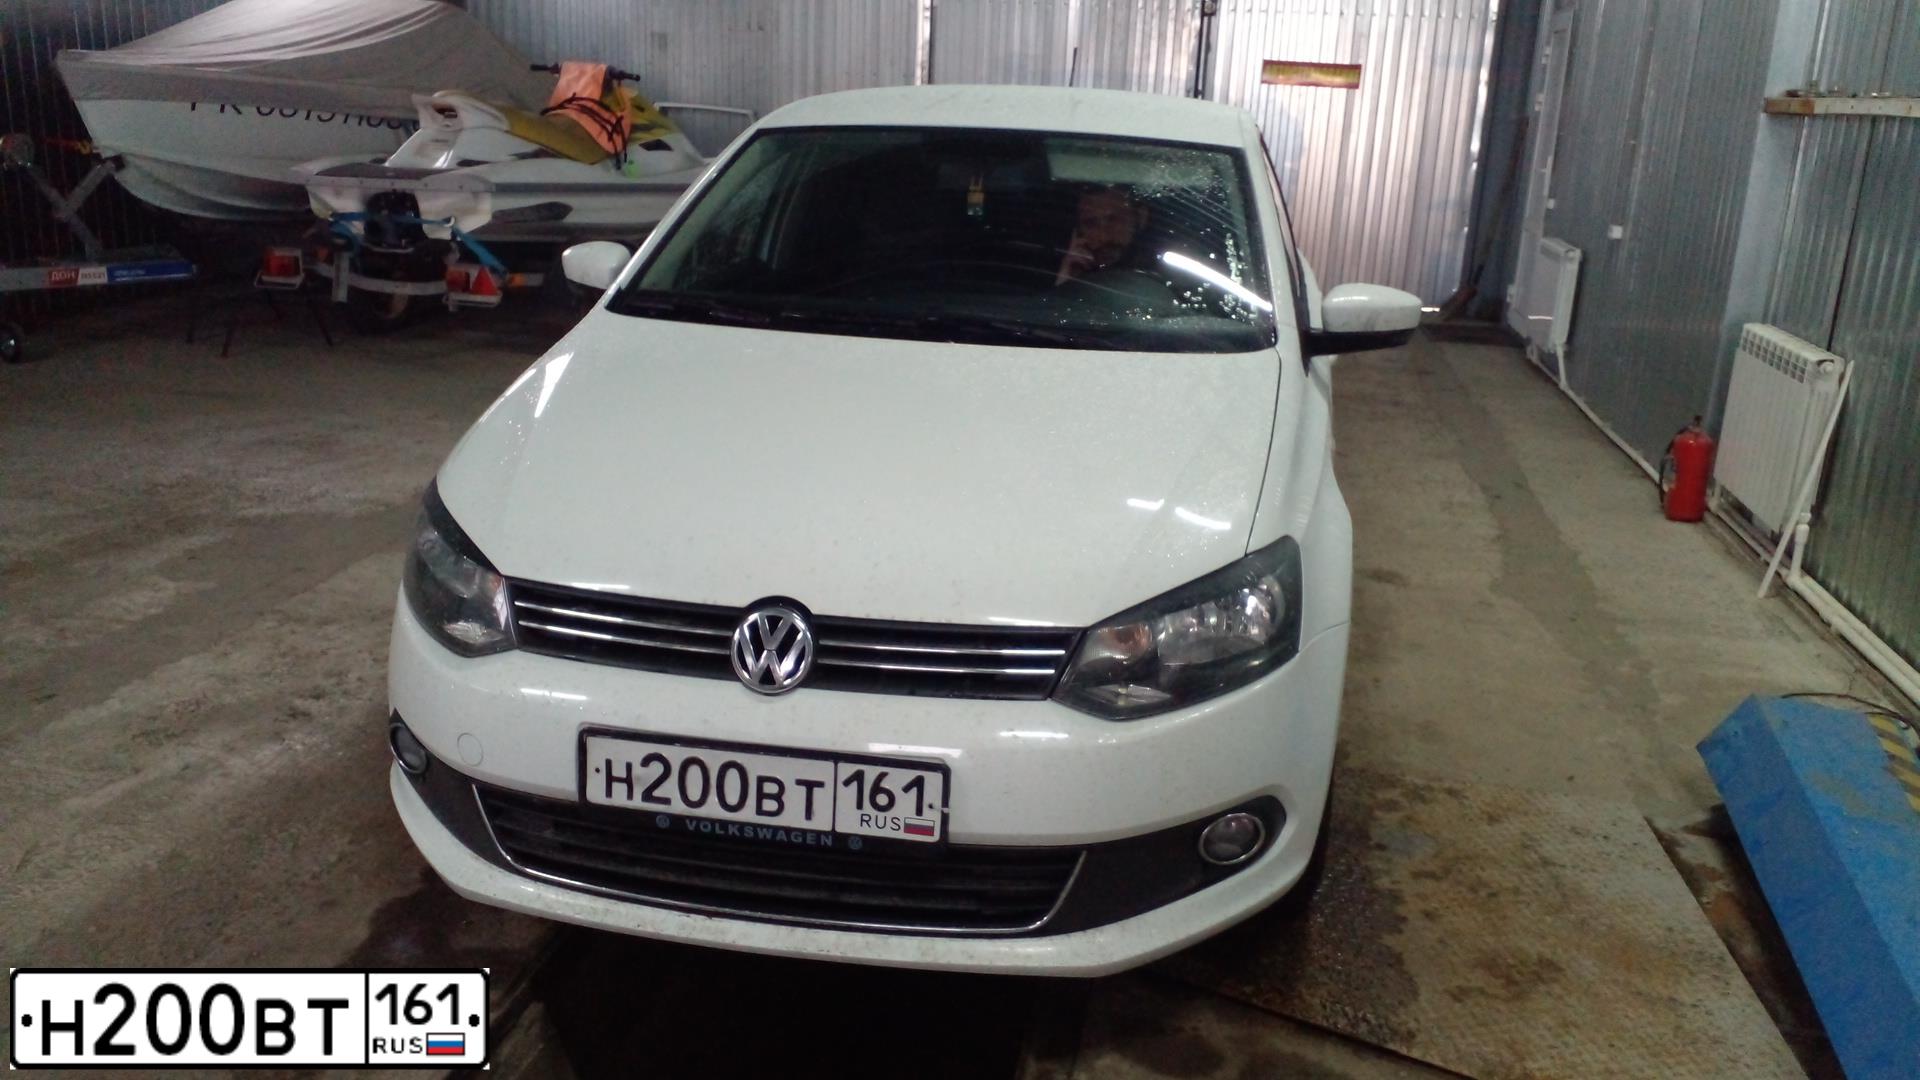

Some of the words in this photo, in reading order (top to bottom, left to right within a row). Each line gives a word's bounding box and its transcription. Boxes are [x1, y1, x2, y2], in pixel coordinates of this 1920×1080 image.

[604, 751, 826, 822] Н200ВТ
[841, 769, 926, 818] 161
[685, 818, 834, 847] VOLKSWAGEN
[859, 813, 902, 833] RUS
